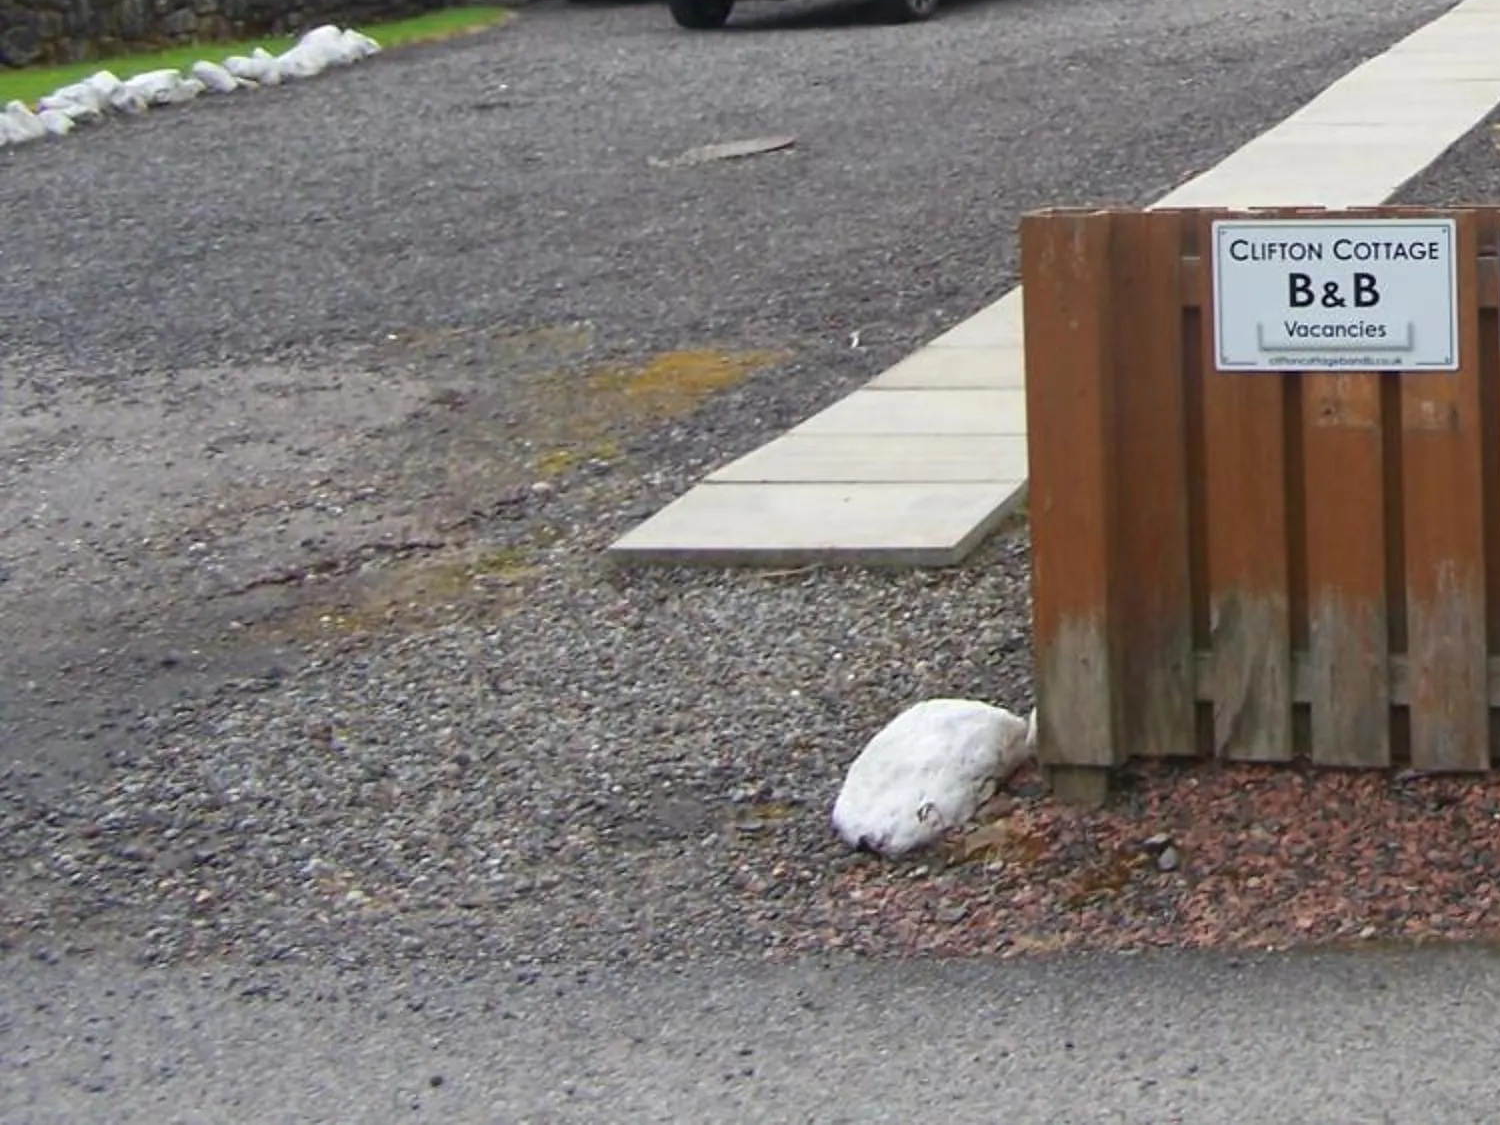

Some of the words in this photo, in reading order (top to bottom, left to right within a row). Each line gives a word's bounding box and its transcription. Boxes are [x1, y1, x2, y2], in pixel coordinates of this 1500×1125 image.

[1229, 239, 1323, 261] CLIFTON
[1333, 238, 1439, 261] COTTAGE
[1284, 321, 1387, 338] Vacancies
